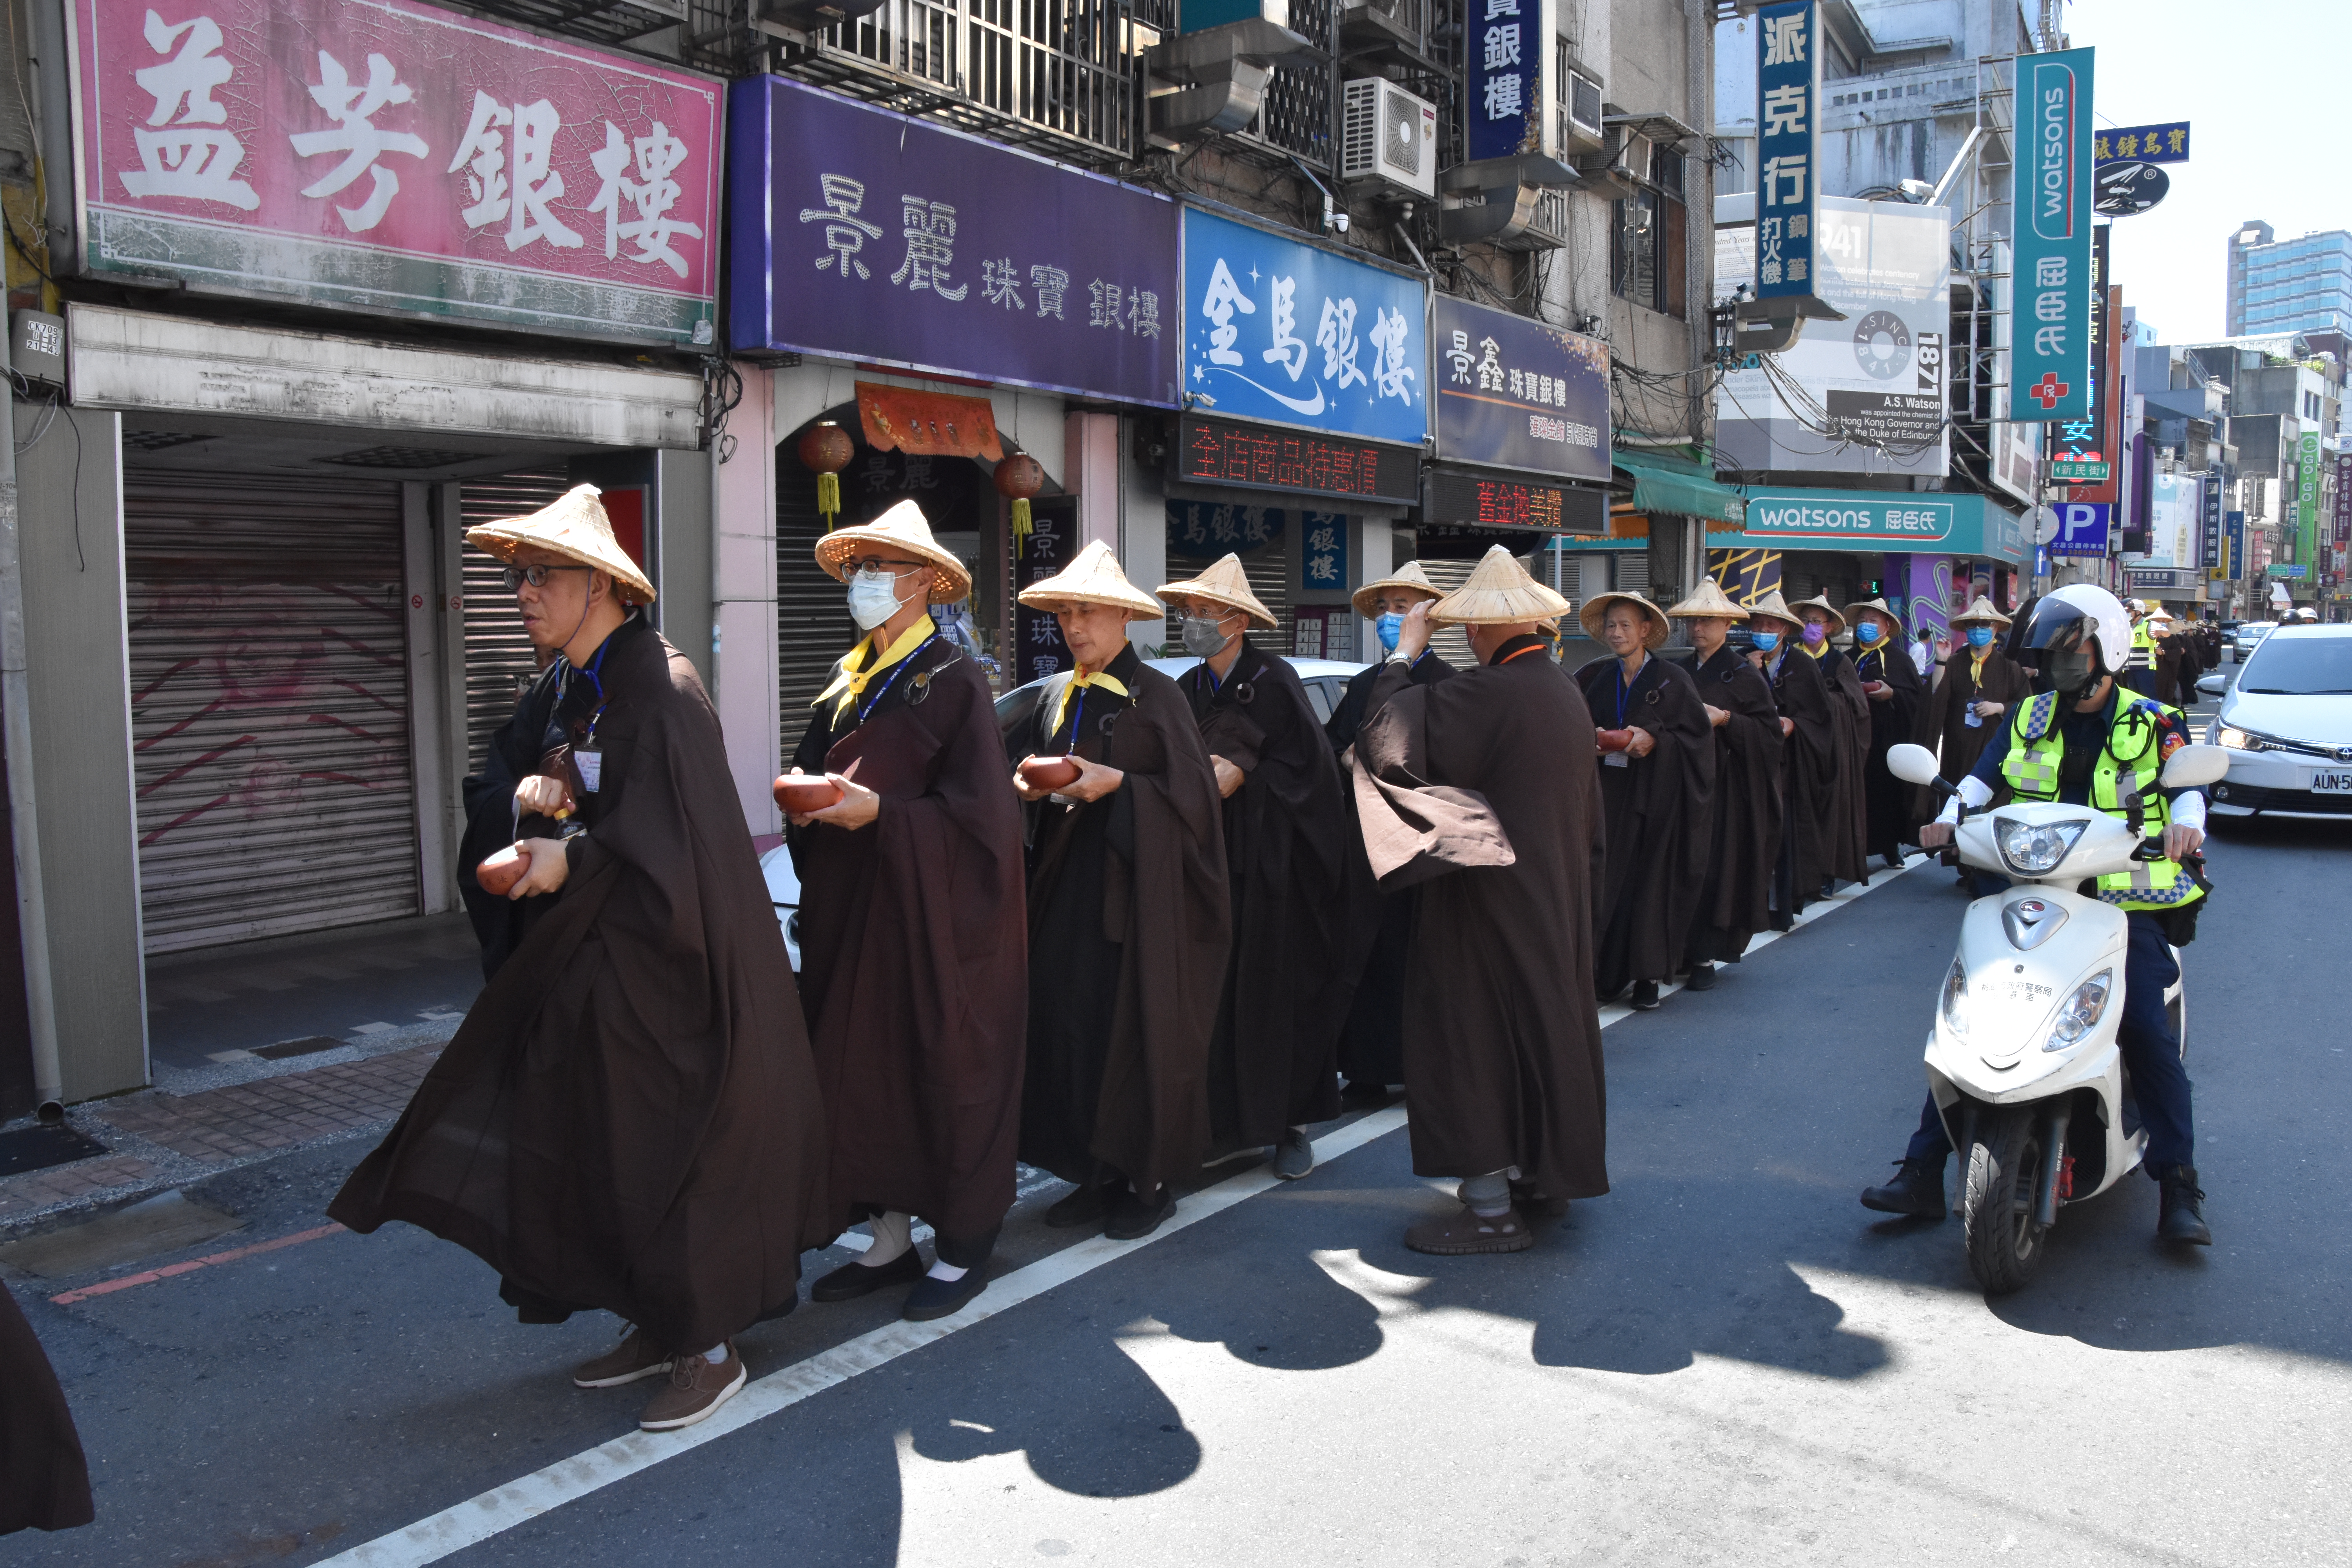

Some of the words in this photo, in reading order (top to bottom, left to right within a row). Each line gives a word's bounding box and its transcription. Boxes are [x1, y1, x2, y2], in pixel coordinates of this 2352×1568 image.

[1762, 8, 1808, 207] 派克行
[118, 8, 703, 279] 益芳銀樓
[2043, 87, 2063, 218] watsons
[1715, 237, 1731, 245] ndred
[1761, 218, 1782, 285] 打火機
[800, 173, 968, 301] 景麗
[982, 257, 1069, 321] 珠寶
[1088, 278, 1161, 339] 銀樓
[1819, 263, 1846, 274] Watson
[1847, 267, 1883, 277] celebrates
[1885, 270, 1919, 281] centenary
[1828, 289, 1841, 297] and
[1855, 290, 1867, 299] fall
[1877, 292, 1896, 303] Hong
[1898, 294, 1916, 305] Kong
[1831, 300, 1867, 311] December
[2035, 256, 2068, 356] 屈臣氏
[29, 322, 62, 336] CK709
[1203, 258, 1415, 408] 金馬銀樓
[1446, 330, 1505, 392] 景鑫
[1510, 368, 1566, 408] 珠寶銀樓
[1918, 334, 1940, 396] 1871
[1746, 375, 1769, 383] Skirvin
[1884, 396, 1903, 408] A.S.
[1906, 397, 1940, 410] Watson
[1567, 422, 1598, 448] 引領時尚
[1840, 416, 1862, 427] Hong
[1864, 417, 1885, 428] Kong
[1887, 418, 1924, 428] Governor
[1925, 421, 1940, 430] and
[1855, 428, 1867, 437] the
[1869, 428, 1891, 438] Duke
[1892, 430, 1900, 438] of
[1901, 430, 1940, 442] Edinbur
[1192, 426, 1379, 496] 全店商品特惠價
[2061, 464, 2101, 476] 新民街
[1760, 506, 1871, 529] watsons
[1885, 510, 1937, 531] 屈臣氏
[2065, 505, 2095, 541] P
[2208, 503, 2218, 558] 伊斯敦眼鏡
[2313, 774, 2352, 789] AUN-5
